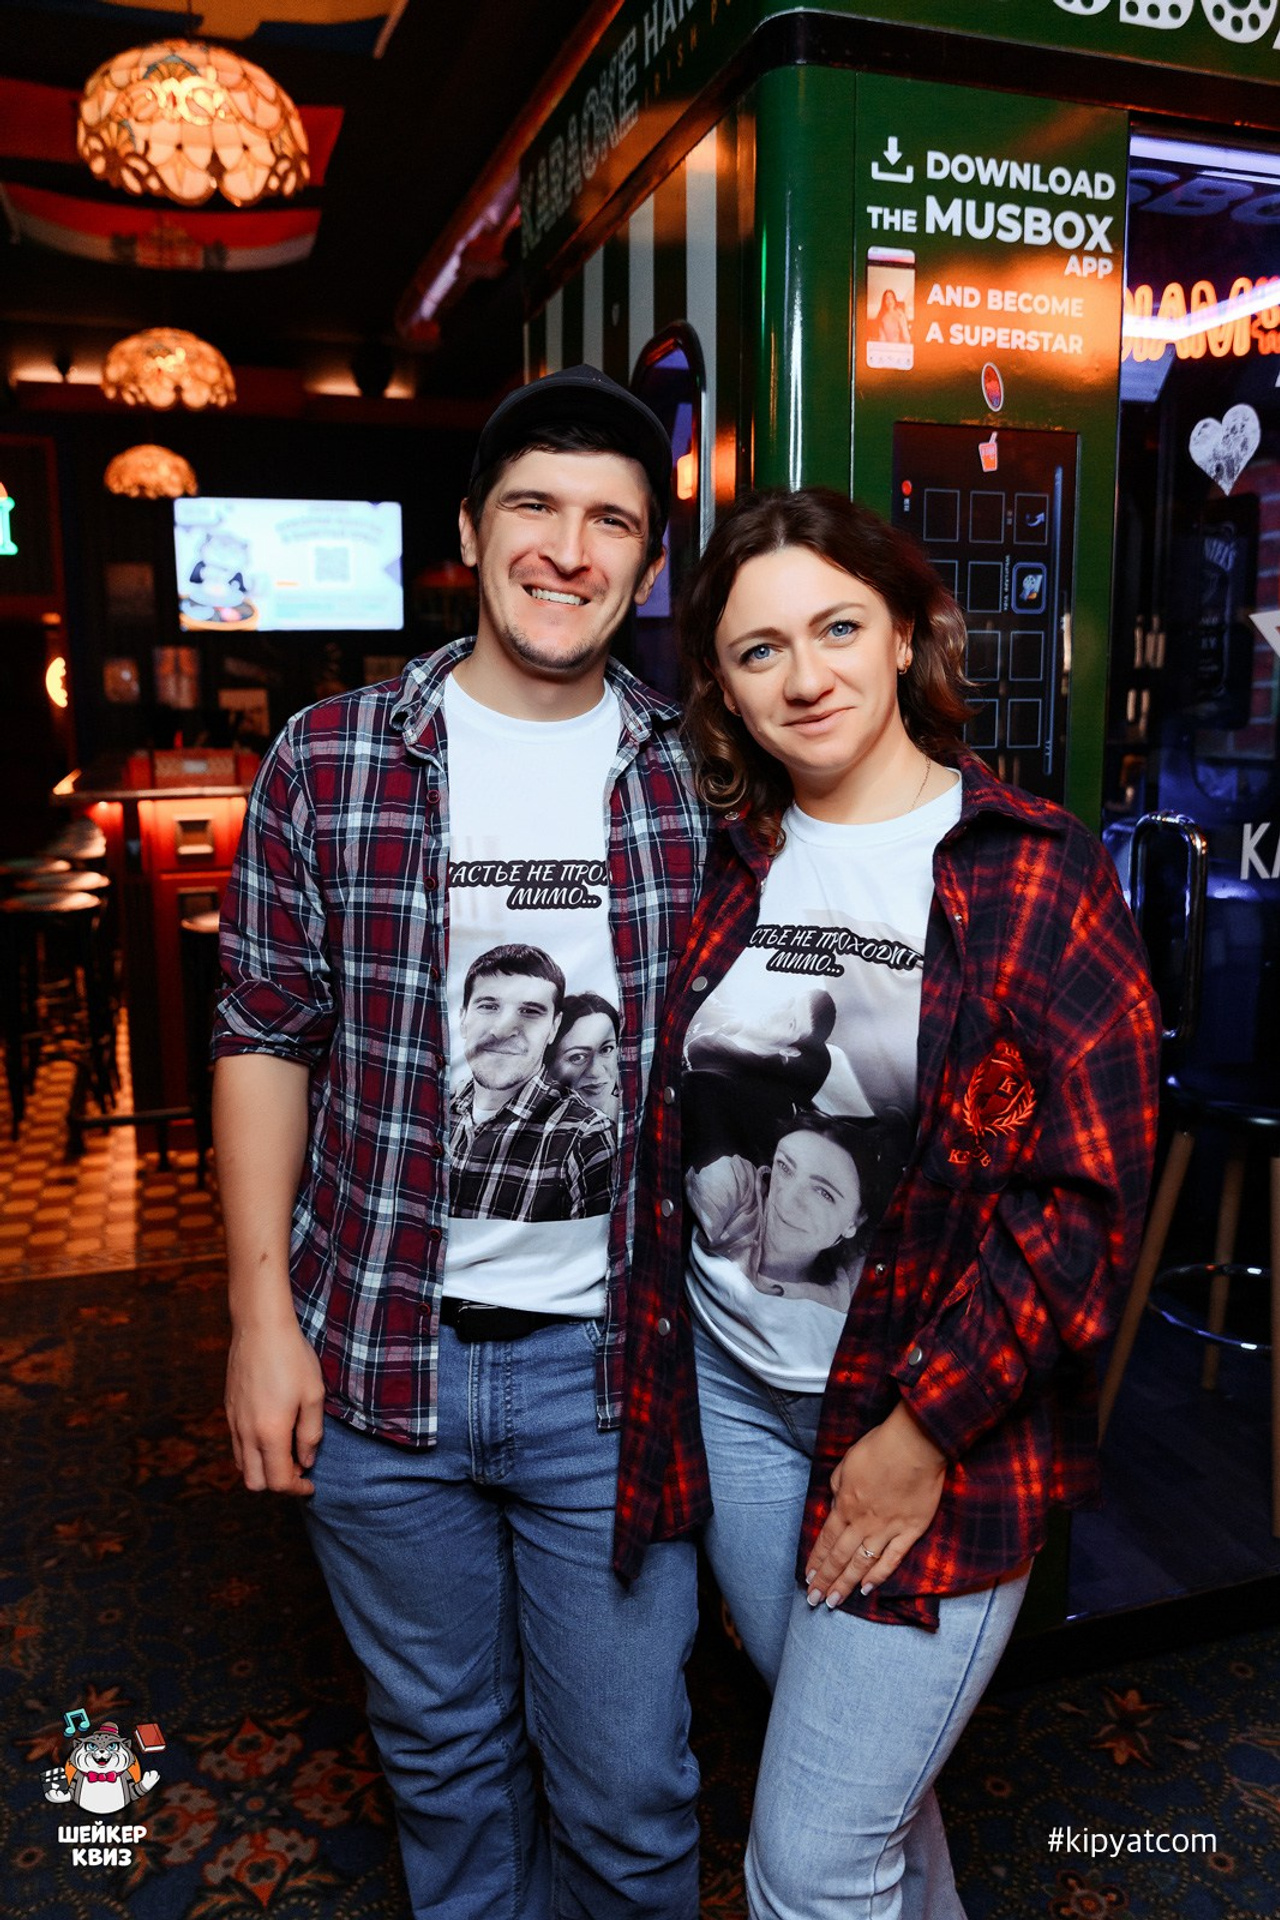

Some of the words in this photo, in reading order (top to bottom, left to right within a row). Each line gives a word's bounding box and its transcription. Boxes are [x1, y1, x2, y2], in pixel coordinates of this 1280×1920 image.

[926, 150, 1116, 201] DOWNLOAD
[866, 205, 917, 233] THE
[925, 195, 1114, 254] MUSBOX
[1064, 254, 1114, 279] APP
[927, 284, 981, 309] AND
[988, 289, 1084, 318] BECOME
[925, 321, 944, 344] A
[949, 324, 1084, 355] SUPERSTAR
[526, 864, 554, 883] НЕ
[511, 888, 598, 906] МИМО...
[790, 930, 817, 947] НЕ
[770, 951, 841, 974] МИМО...
